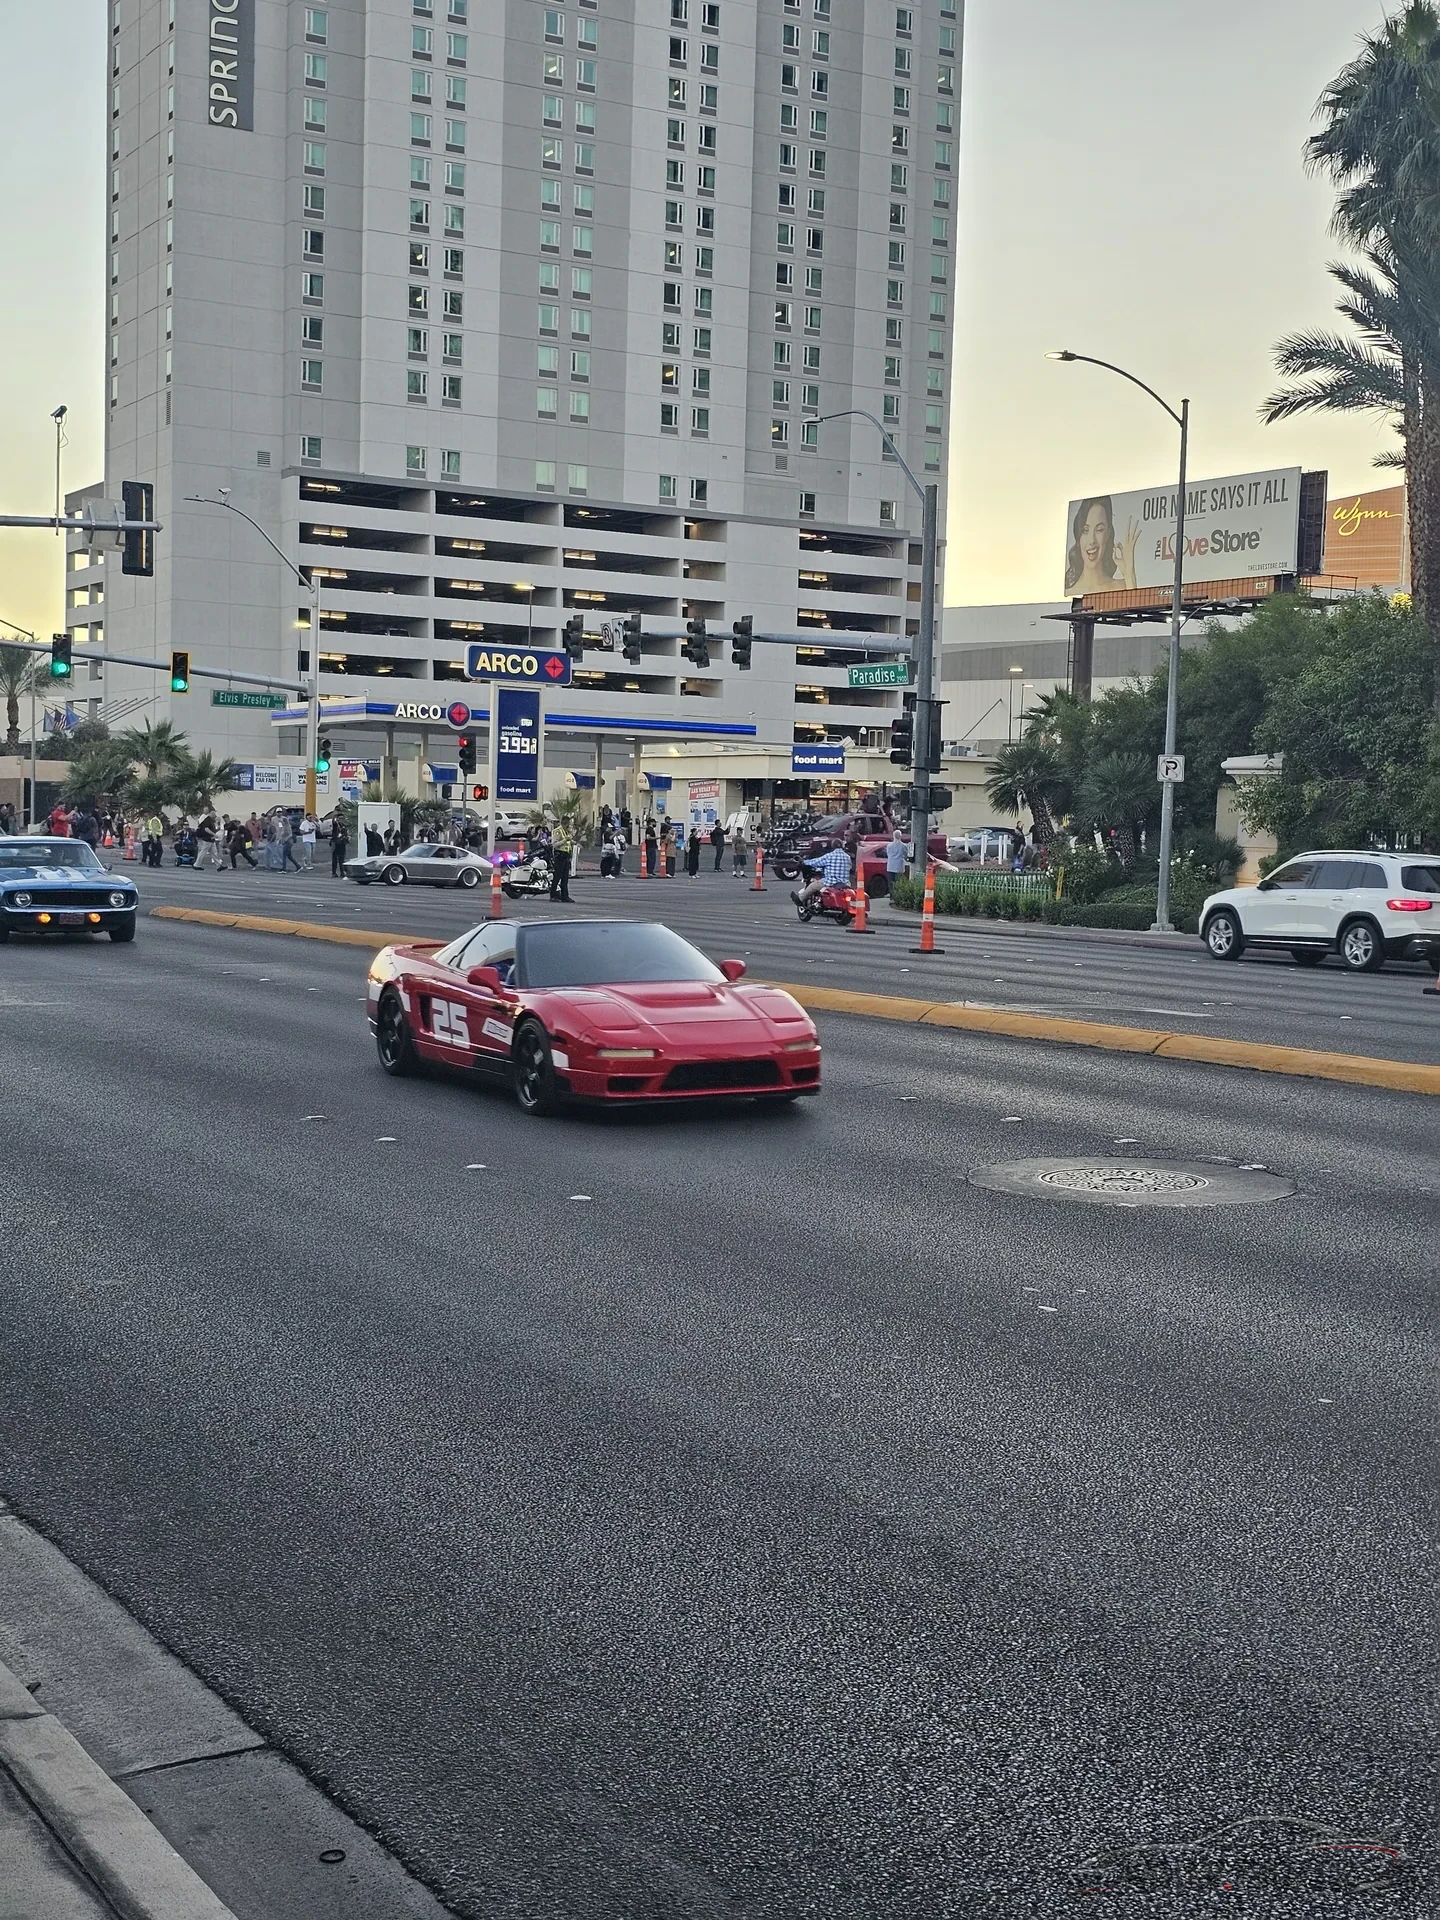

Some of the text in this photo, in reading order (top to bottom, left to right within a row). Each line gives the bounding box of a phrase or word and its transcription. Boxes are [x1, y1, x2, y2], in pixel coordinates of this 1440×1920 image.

[1143, 496, 1167, 521] OUR
[1210, 484, 1245, 512] SAYS
[1248, 481, 1261, 506] IT
[1263, 478, 1289, 504] ALL
[1333, 497, 1403, 536] Wynn
[1210, 529, 1260, 554] Store
[475, 651, 539, 676] ARCO
[852, 668, 896, 684] Paradise
[220, 692, 239, 703] Elvis
[242, 693, 271, 707] Presley
[394, 702, 442, 720] ARCO
[794, 755, 843, 765] food mart
[431, 997, 470, 1049] 25
